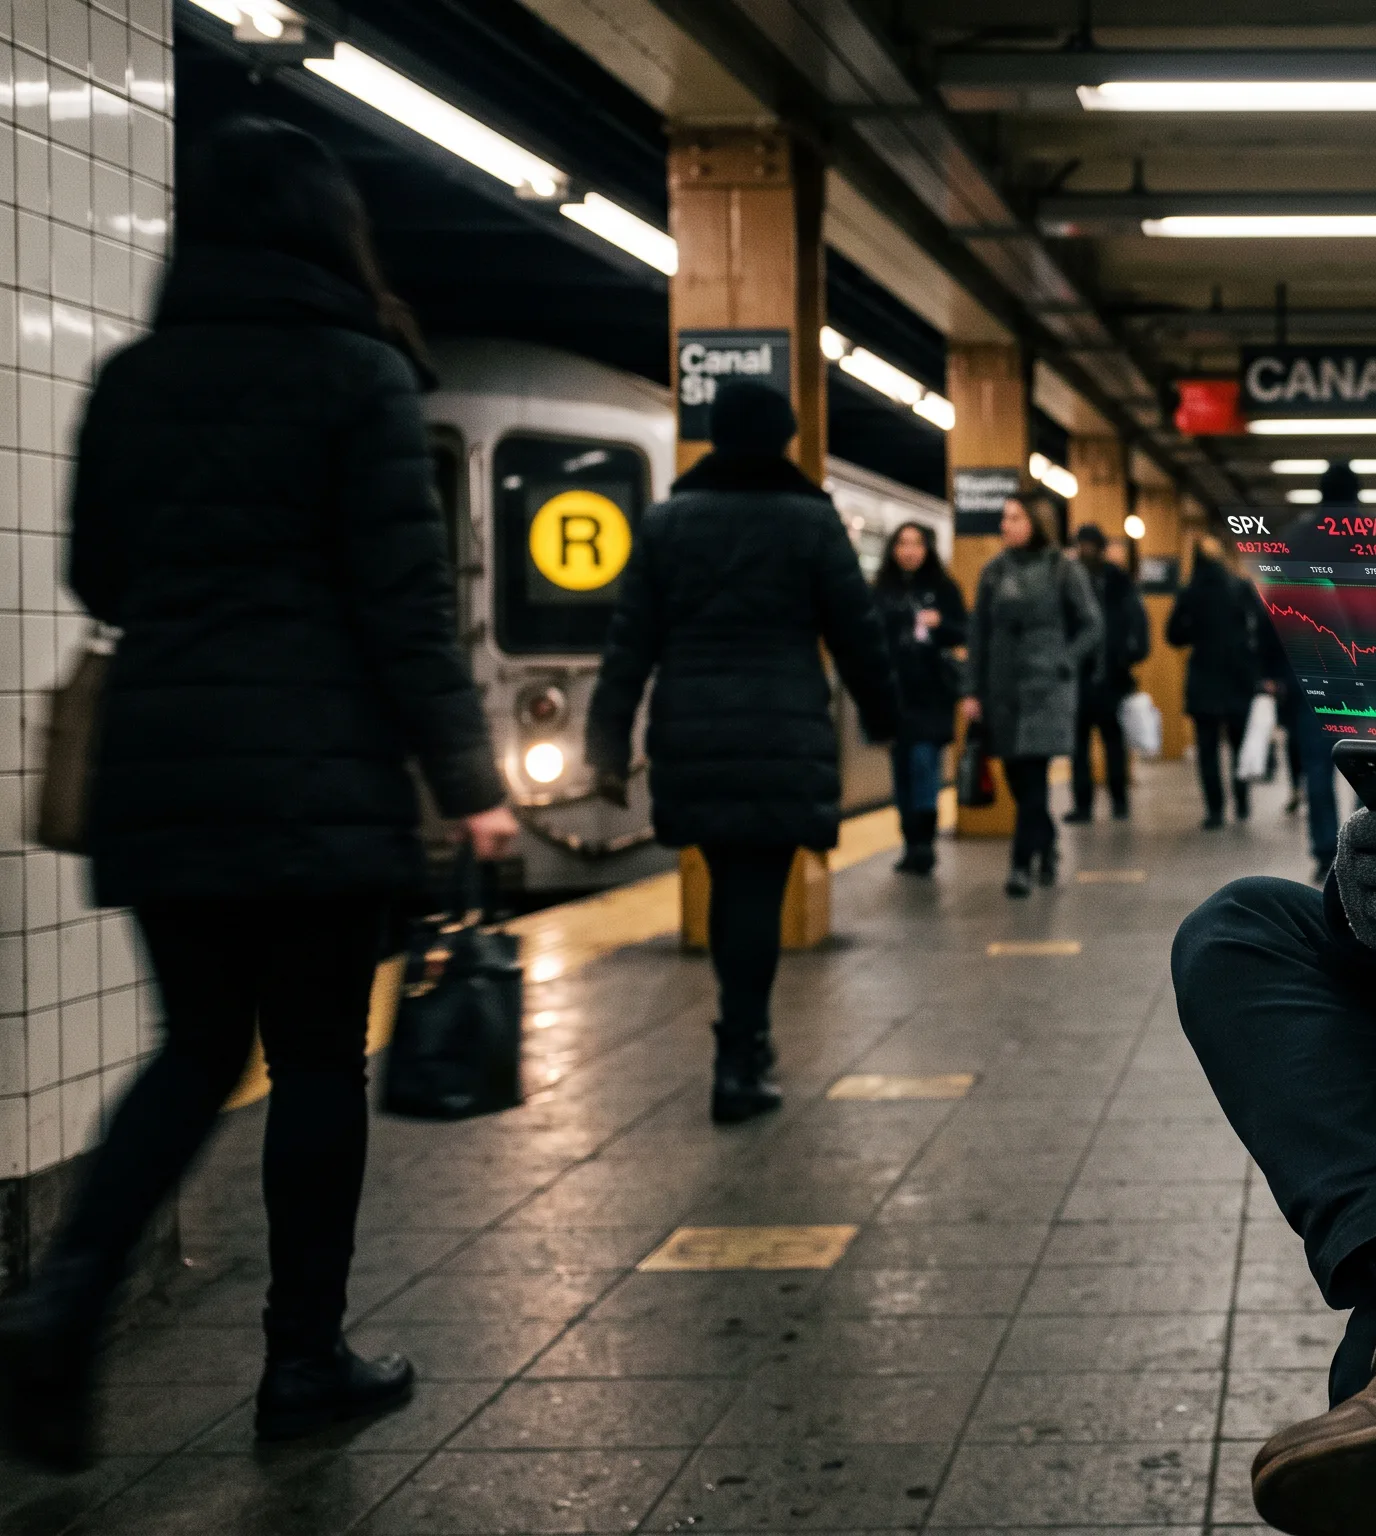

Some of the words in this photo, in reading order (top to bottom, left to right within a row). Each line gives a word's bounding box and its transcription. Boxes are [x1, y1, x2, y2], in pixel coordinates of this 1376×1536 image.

[680, 342, 773, 375] Canal
[559, 514, 602, 567] R
[1227, 516, 1270, 534] SPX
